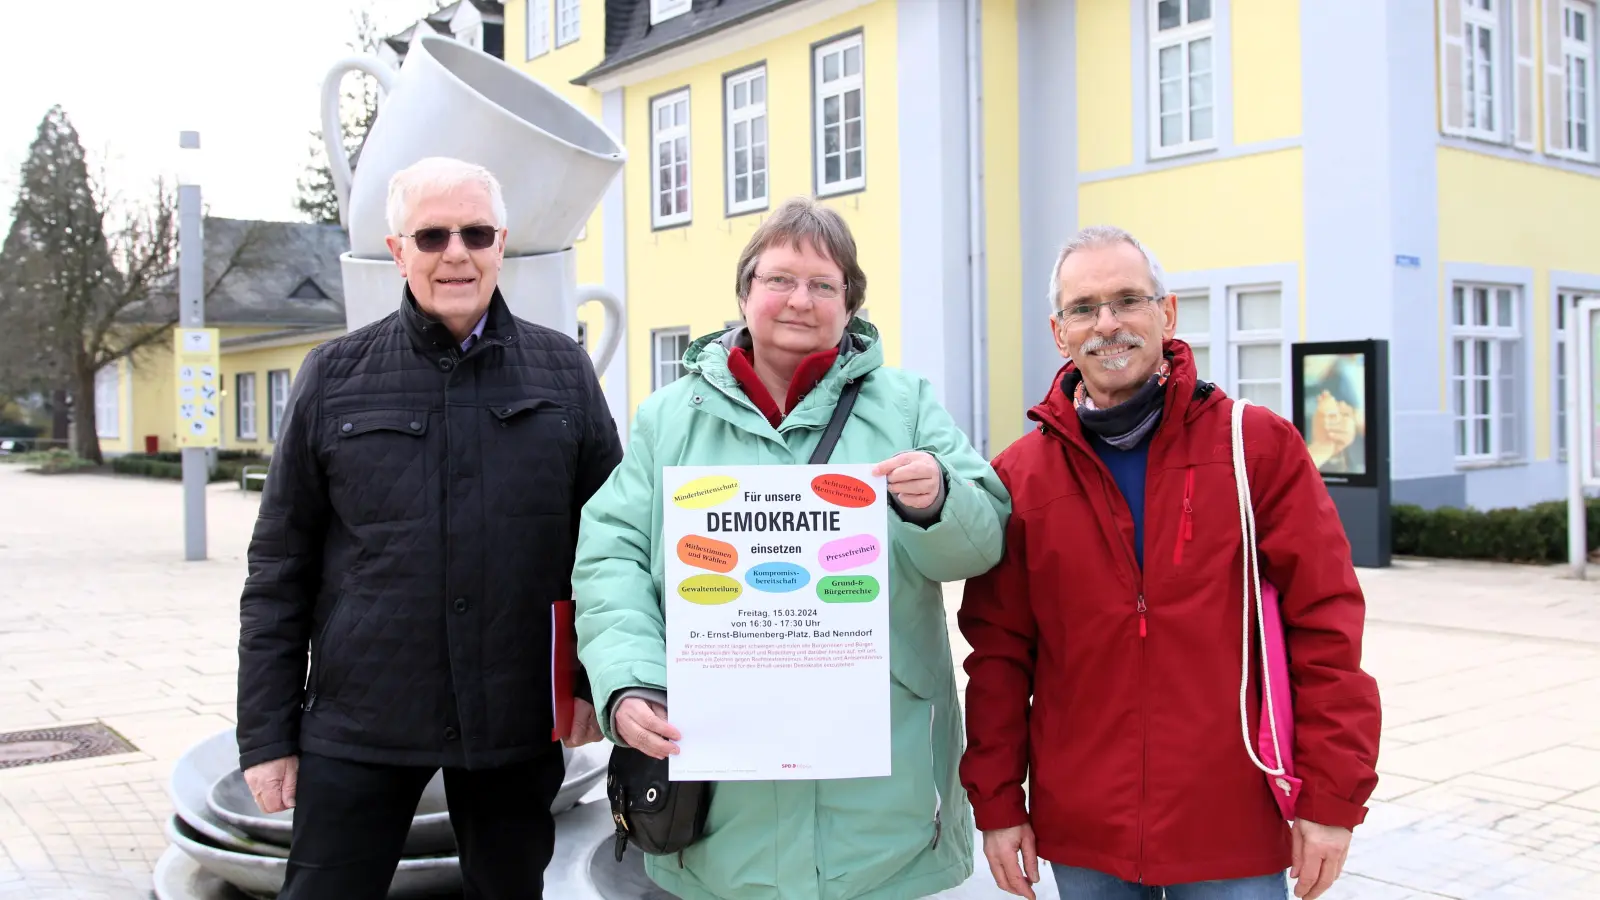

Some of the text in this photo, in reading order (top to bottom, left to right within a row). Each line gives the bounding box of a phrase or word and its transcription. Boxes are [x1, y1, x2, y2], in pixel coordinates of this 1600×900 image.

[822, 479, 852, 492] Achtung
[674, 482, 738, 502] Minderheitenschutz
[744, 491, 802, 502] Für unsere
[814, 484, 871, 504] Menschenrechte
[706, 511, 840, 532] DEMOKRATIE
[685, 542, 732, 559] Mitbestimmen
[751, 543, 802, 554] einsetzen
[826, 544, 876, 562] Pressefreiheit
[688, 551, 727, 565] und Wählen
[753, 570, 800, 578] Kompromiss-
[756, 576, 797, 585] bereitschaft
[832, 579, 864, 587] Grund-&
[682, 585, 738, 594] Gewaltenteilung
[824, 586, 872, 596] Bürgerrechte
[707, 630, 811, 639] Ernst-Blumenberg-Platz,
[832, 629, 872, 637] Nenndorf
